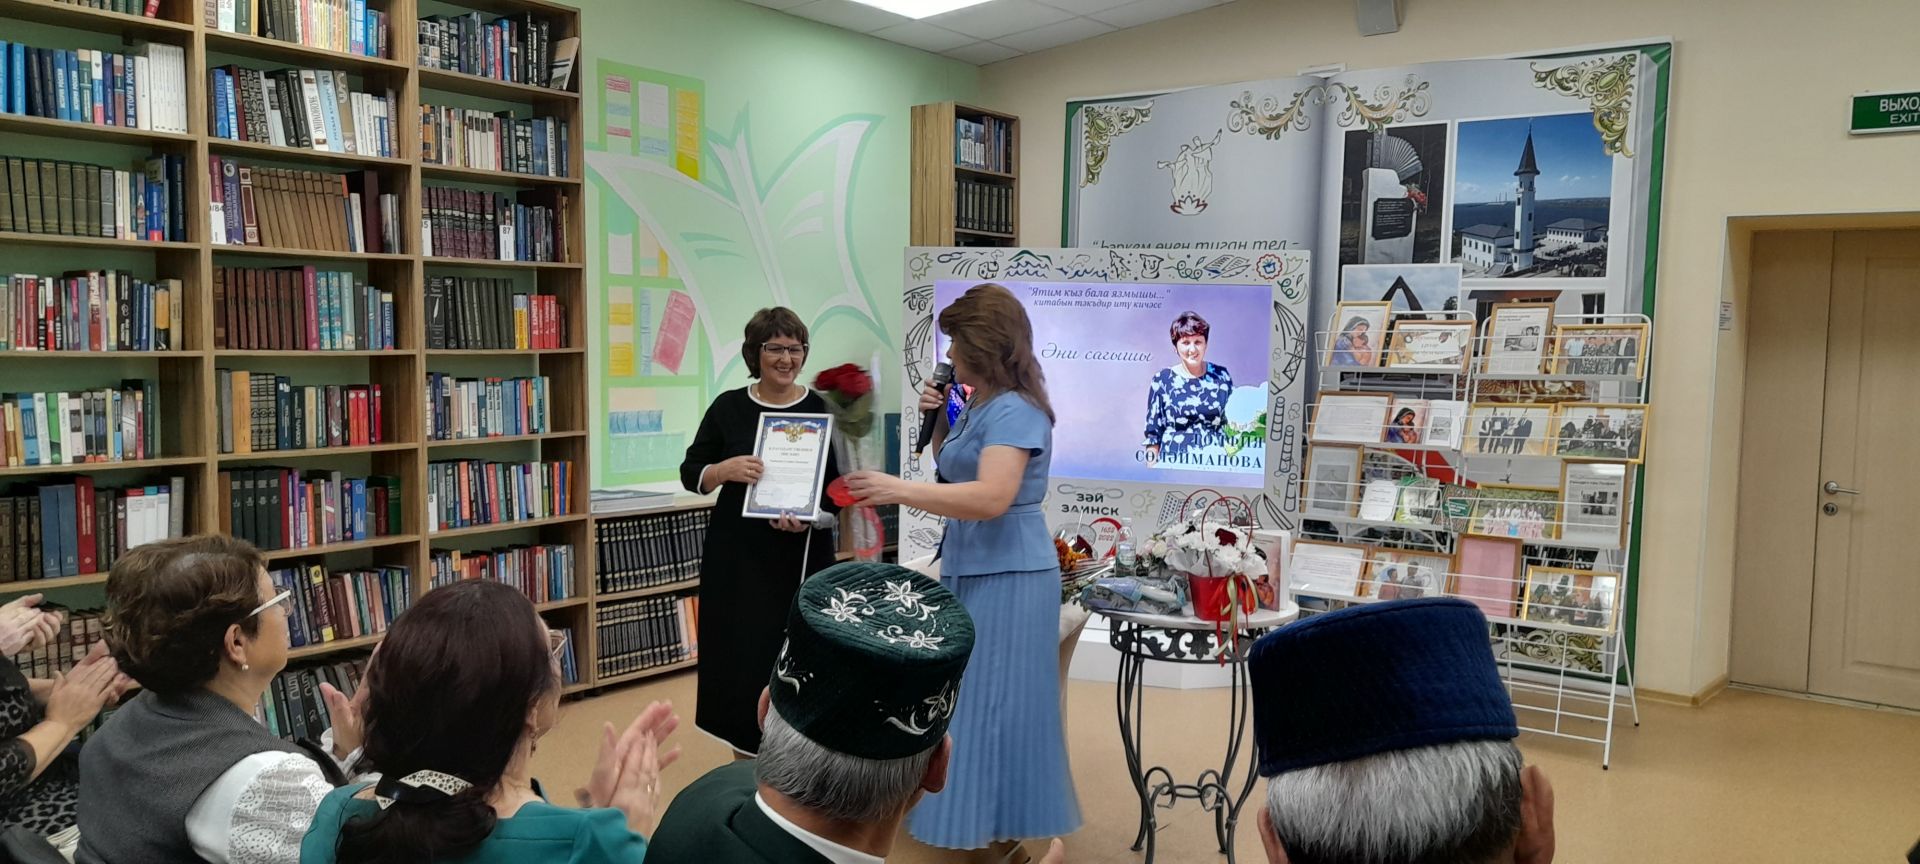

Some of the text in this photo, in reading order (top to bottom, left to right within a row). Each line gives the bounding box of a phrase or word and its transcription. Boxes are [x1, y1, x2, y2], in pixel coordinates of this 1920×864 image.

[1879, 97, 1920, 112] ВЫХО
[1890, 113, 1920, 124] EXIT
[502, 226, 511, 235] 87
[1252, 239, 1287, 250] тел
[1064, 289, 1083, 298] кыз
[1084, 287, 1109, 298] бала
[1033, 299, 1073, 307] китабын
[1041, 342, 1153, 362] Әни сагышы
